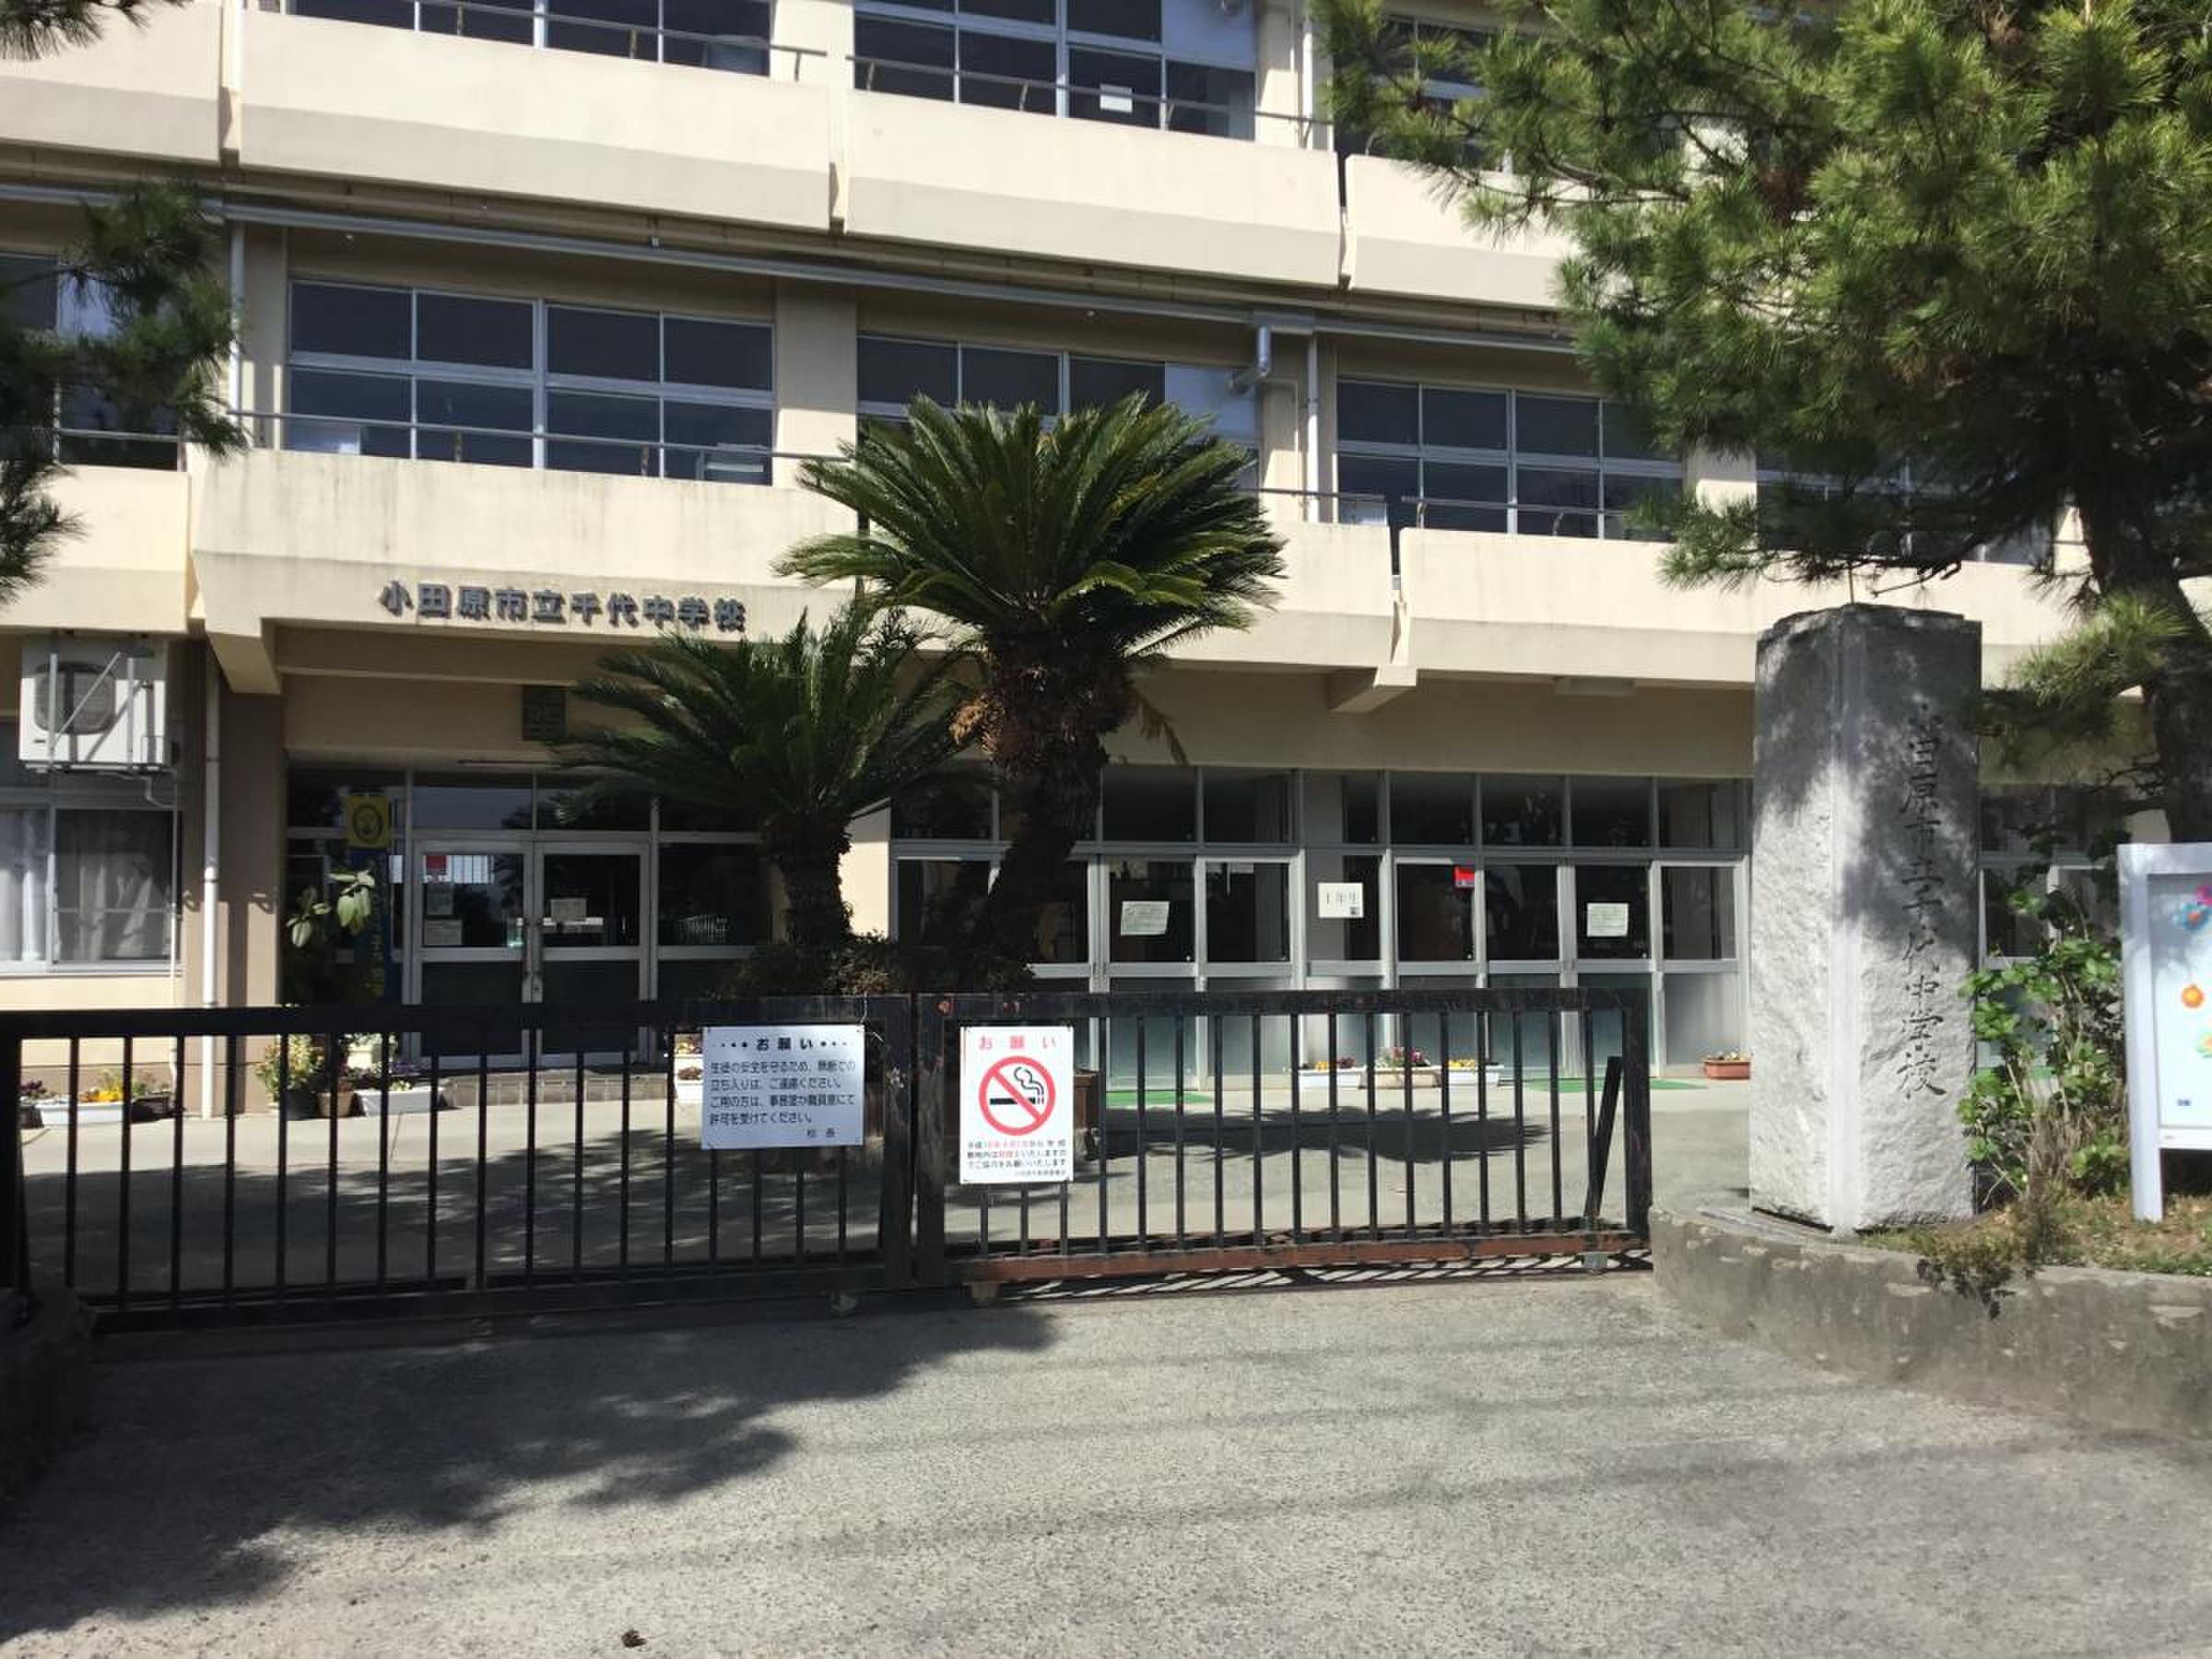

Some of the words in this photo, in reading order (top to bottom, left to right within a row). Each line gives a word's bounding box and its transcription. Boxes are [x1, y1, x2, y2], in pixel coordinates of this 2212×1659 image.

[380, 580, 747, 633] 小田原市立千代中学校
[978, 1035, 1056, 1050] お願い
